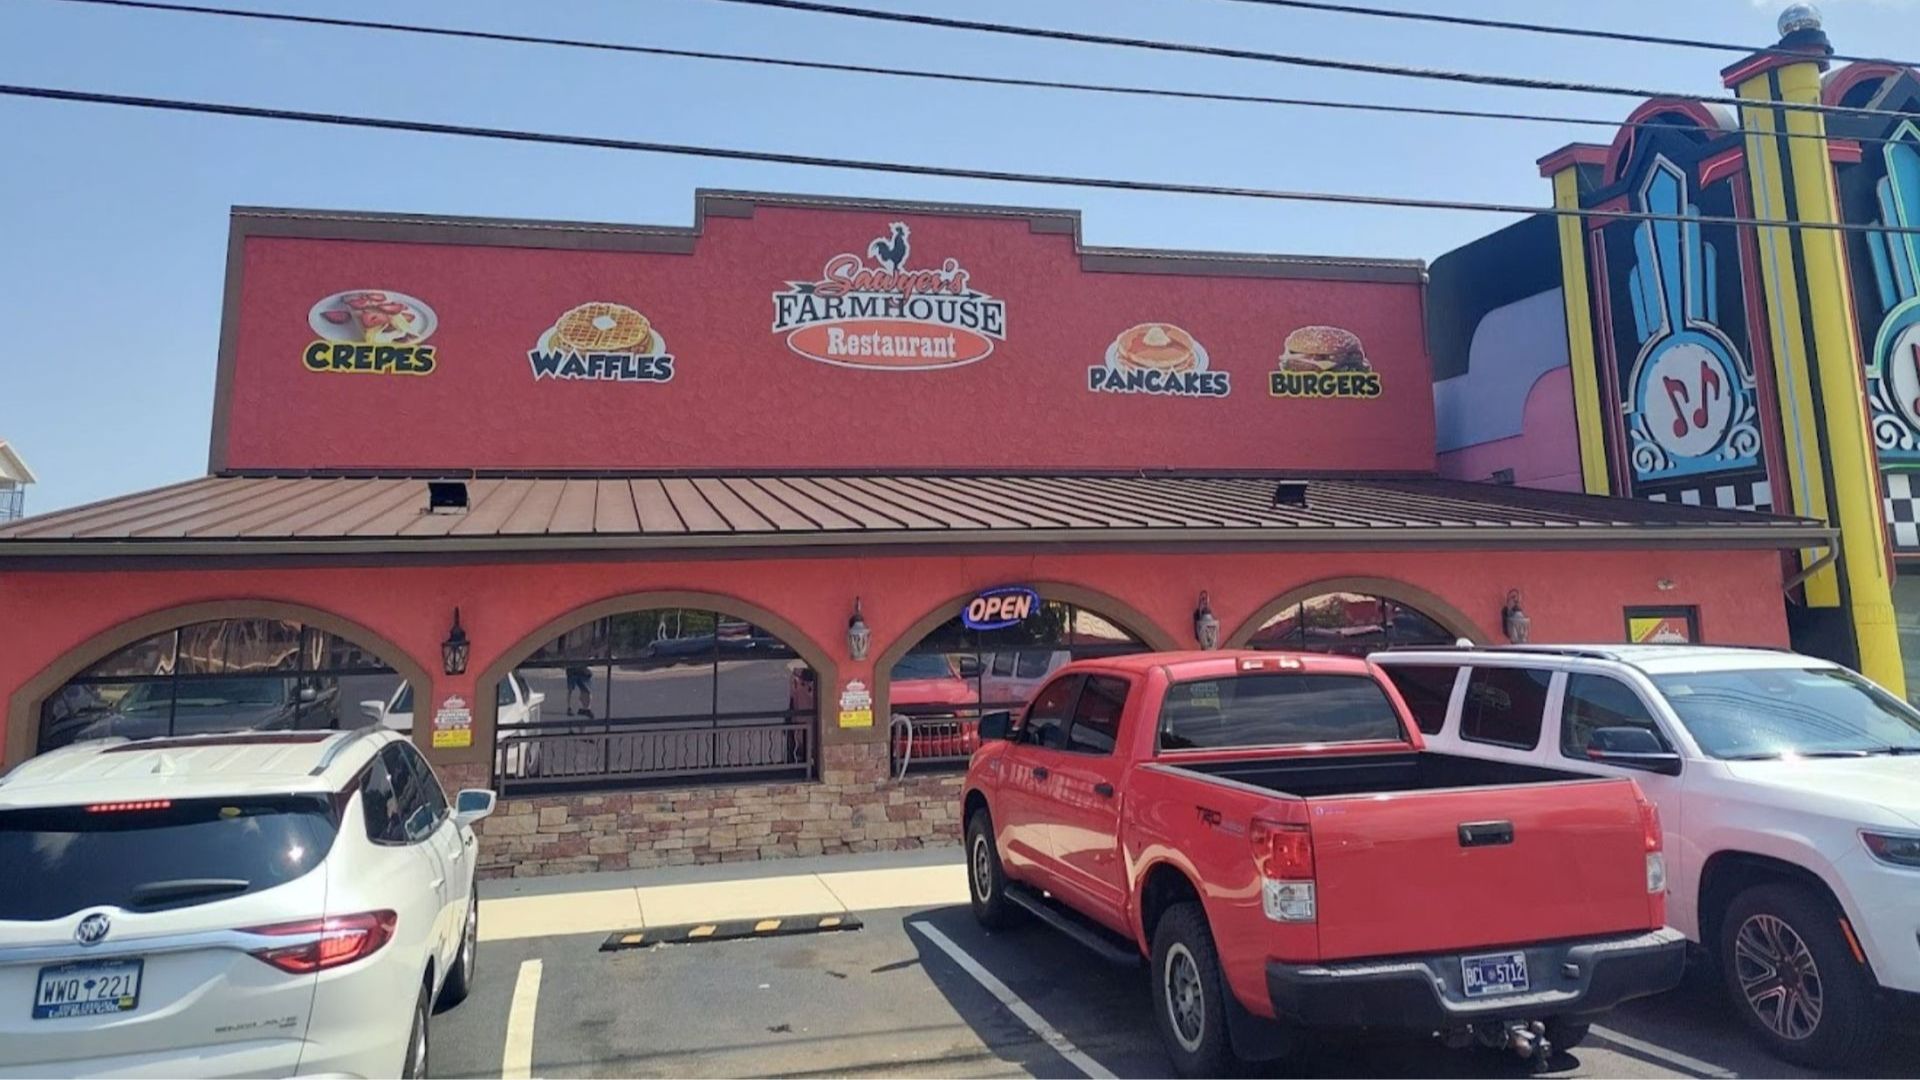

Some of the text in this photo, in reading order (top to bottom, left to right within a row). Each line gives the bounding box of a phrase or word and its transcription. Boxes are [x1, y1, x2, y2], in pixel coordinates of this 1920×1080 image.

[814, 257, 966, 306] Sawyer's
[775, 294, 1002, 335] FARMHOUSE
[304, 342, 434, 373] CREPES
[827, 327, 956, 358] Restaurant
[530, 349, 673, 381] WAFFLES
[1089, 367, 1230, 396] PANCAKES
[1270, 372, 1381, 397] BURGERS
[968, 595, 1032, 622] OPEN
[97, 974, 131, 999] 221
[1465, 962, 1525, 987] BCL 5712
